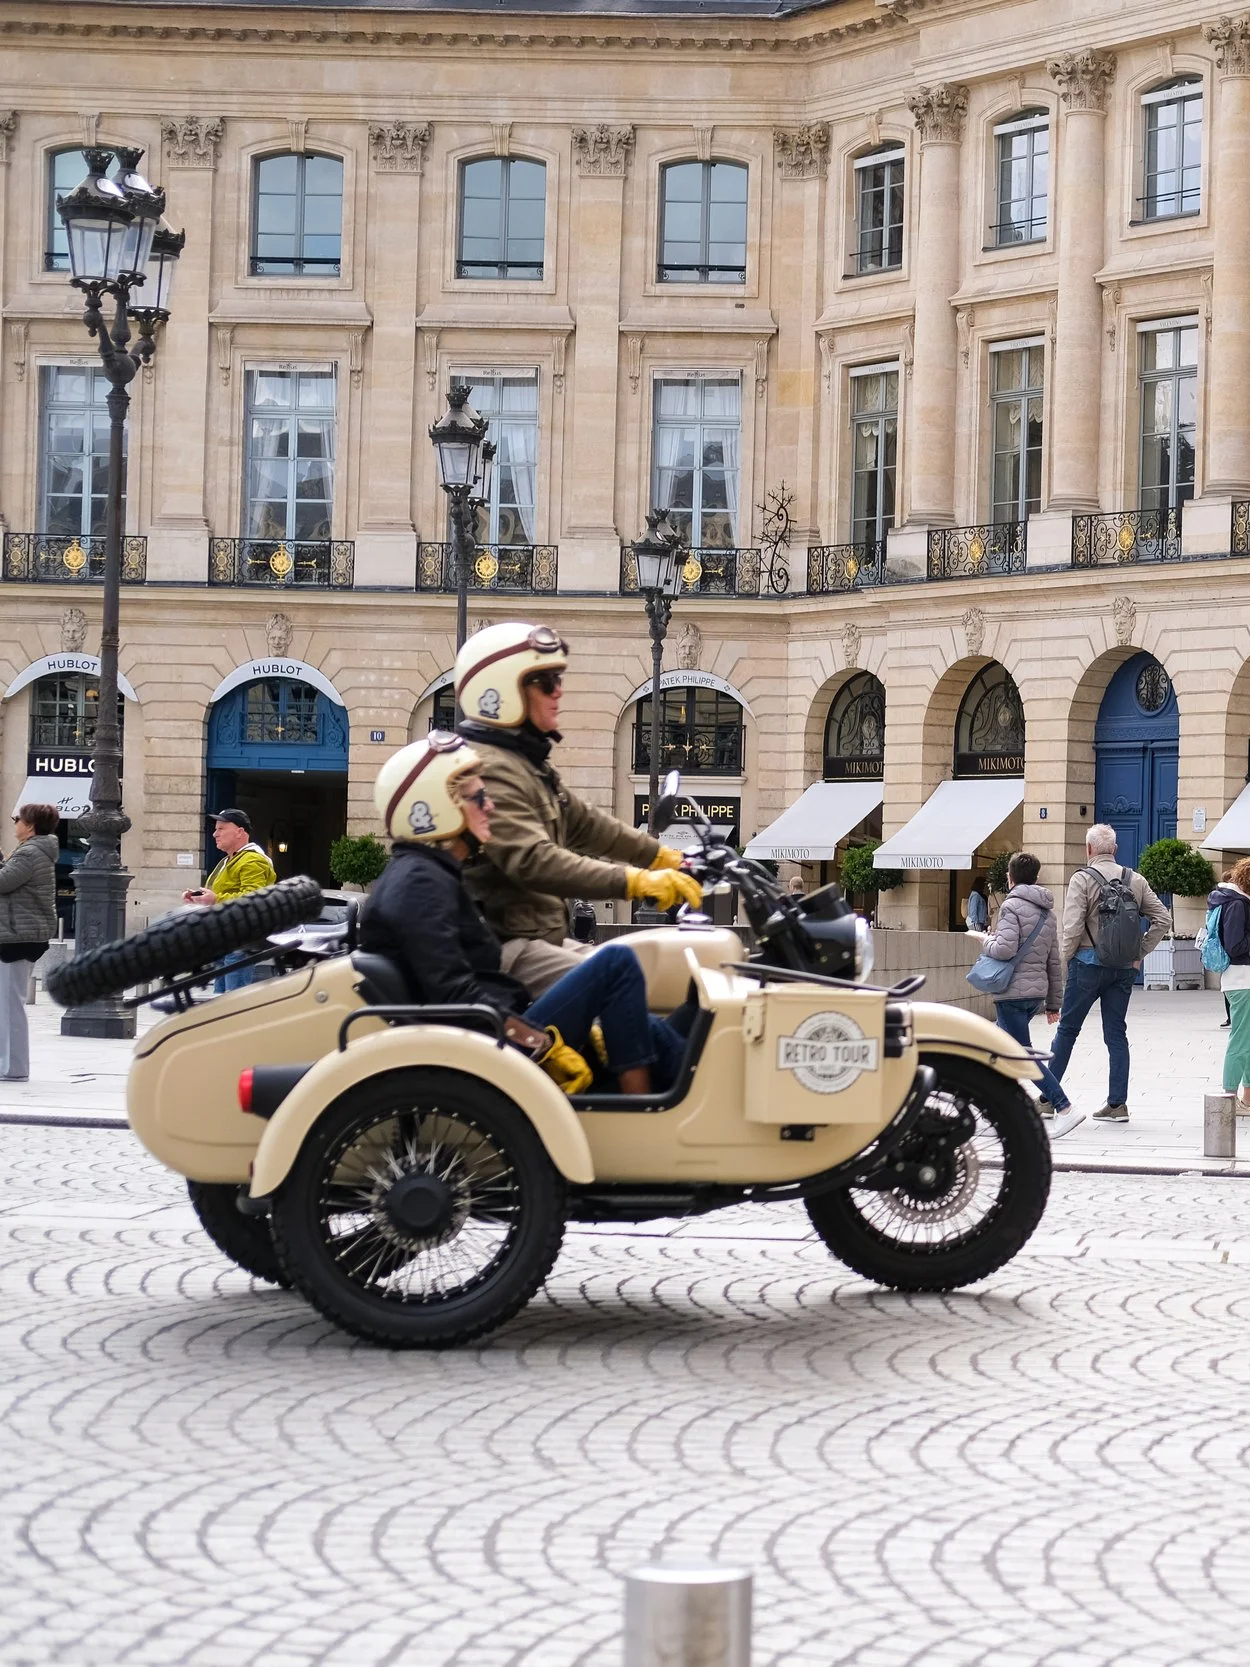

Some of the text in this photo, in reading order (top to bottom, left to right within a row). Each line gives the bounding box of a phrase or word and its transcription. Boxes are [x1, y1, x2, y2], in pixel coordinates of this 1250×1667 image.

[47, 659, 98, 671] HUBLOT
[252, 664, 303, 676] HUBLOT
[682, 675, 716, 687] PHILIPPE
[373, 731, 382, 741] 10
[845, 760, 883, 774] MIKIMOT
[771, 848, 810, 859] MIKIMOTO
[901, 856, 944, 868] MIKIMOTO
[783, 1041, 870, 1065] RETRO TOUR
